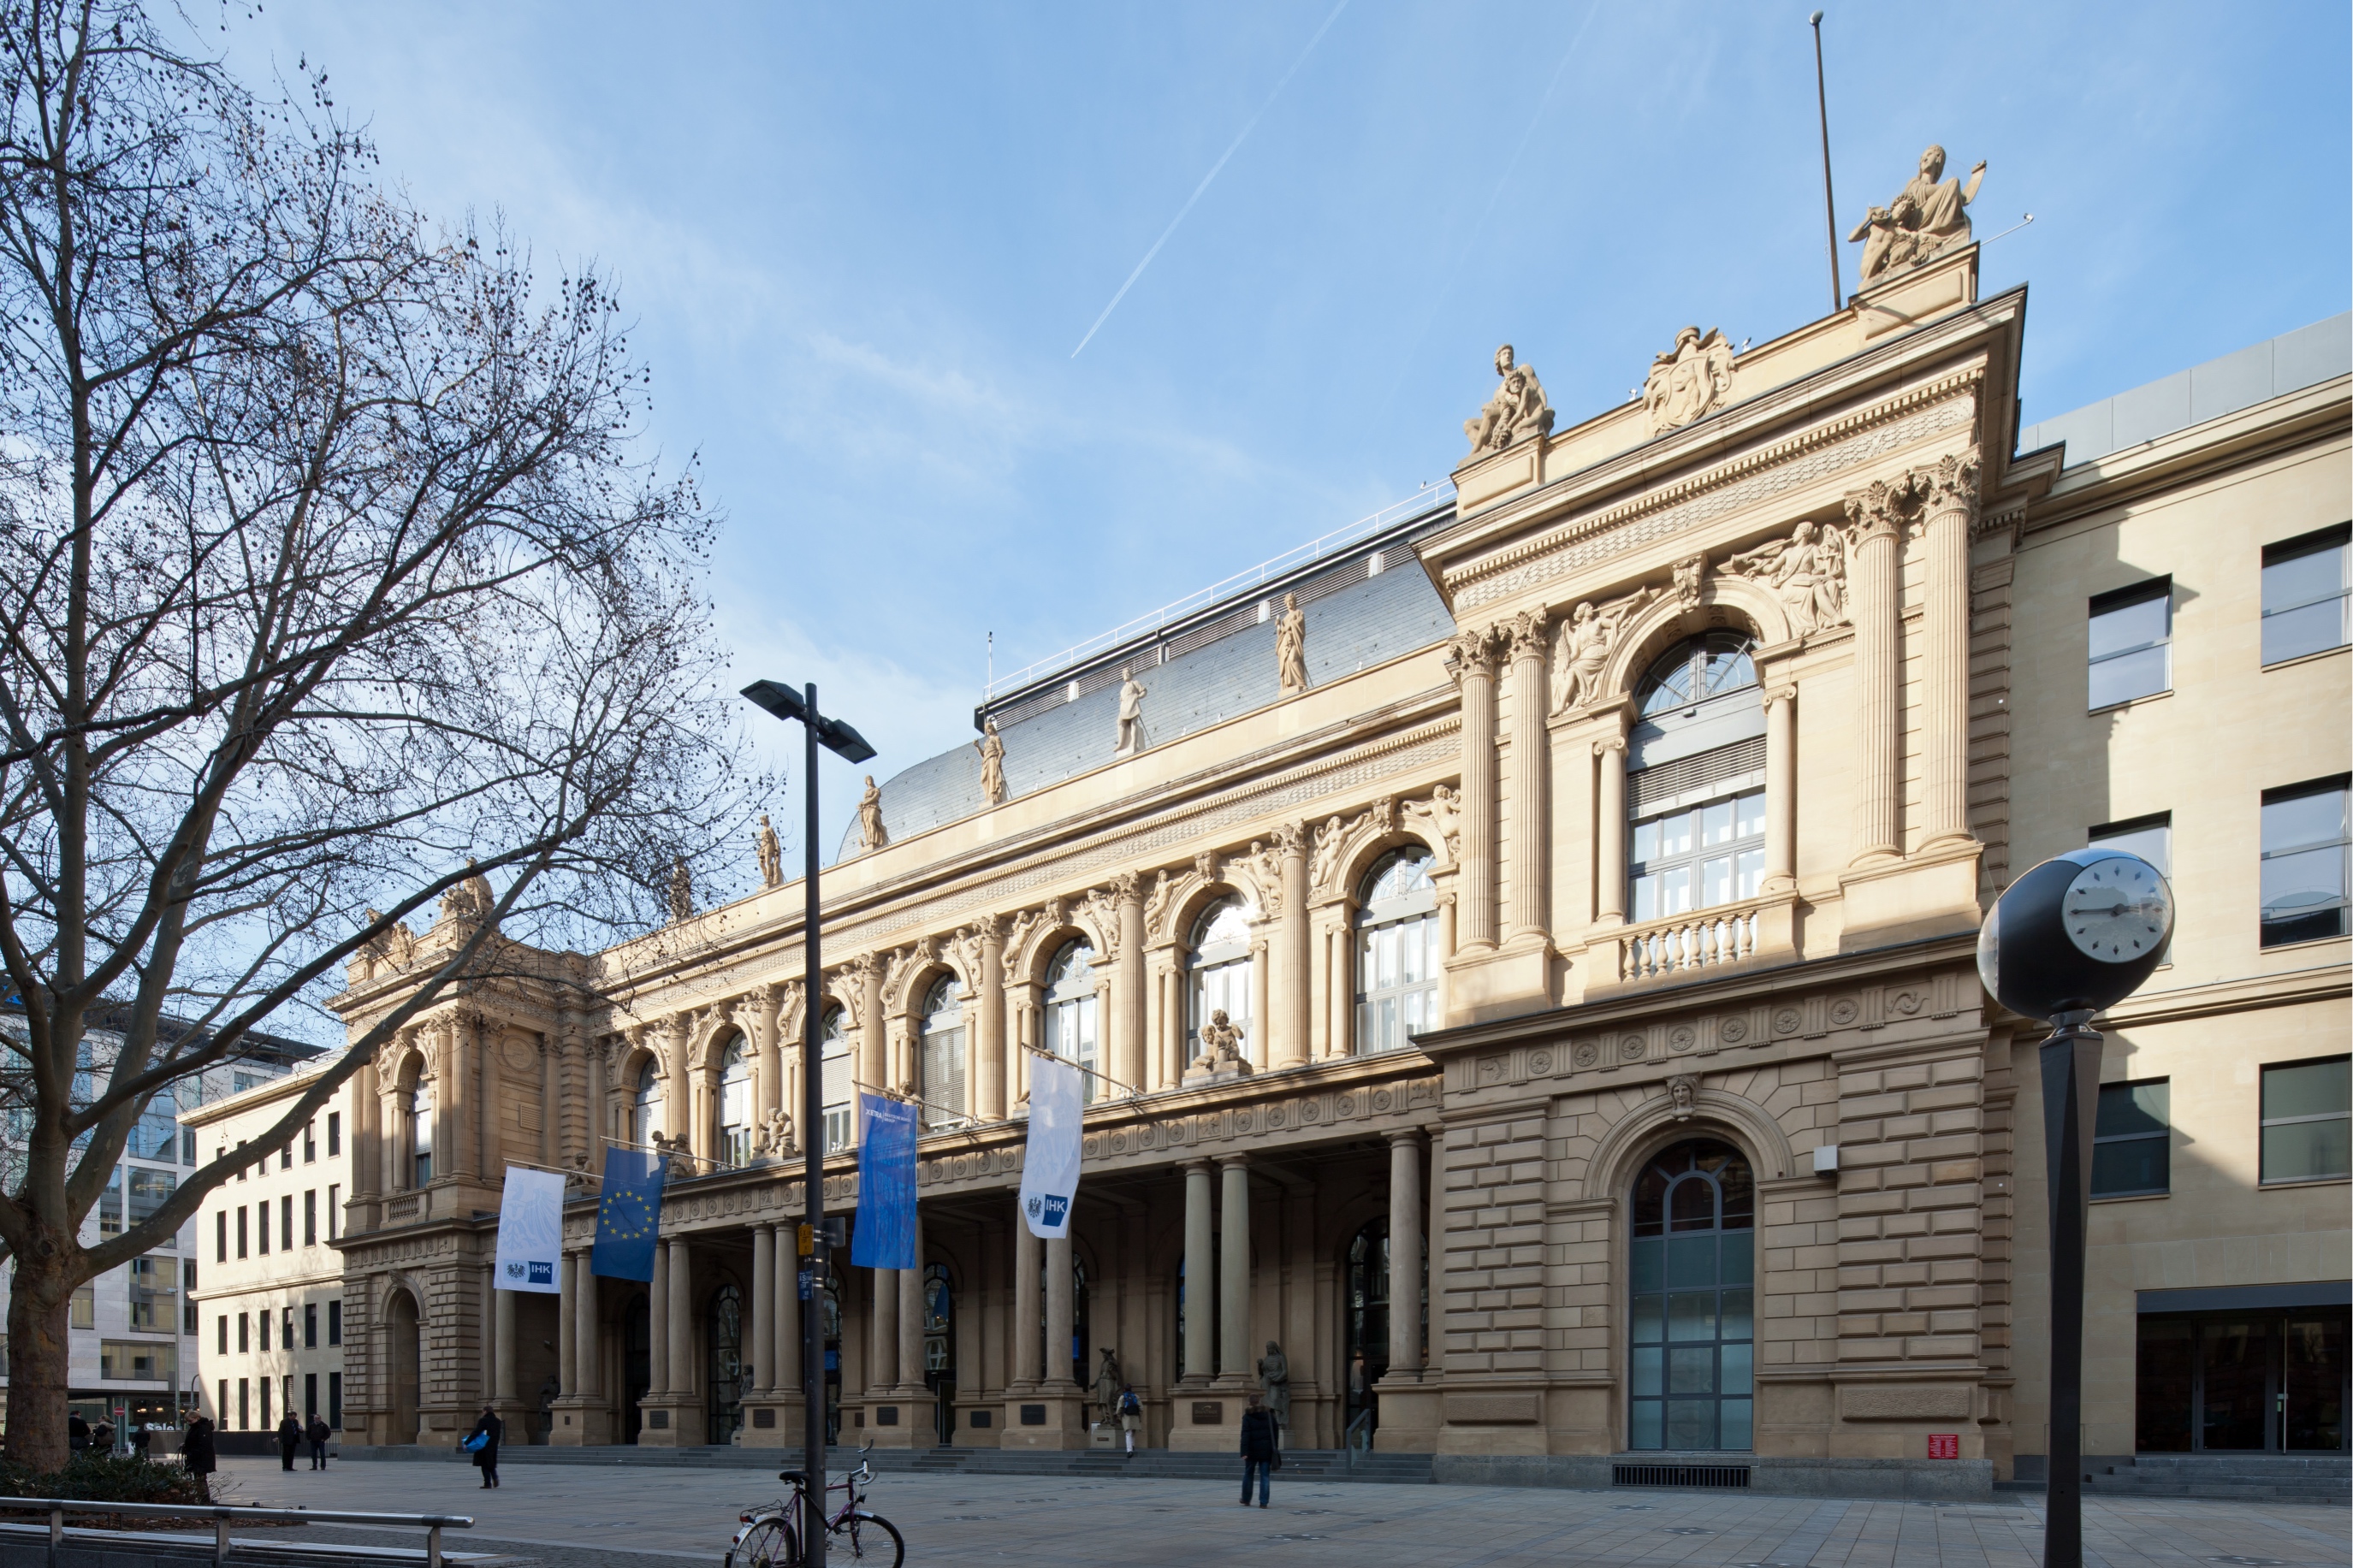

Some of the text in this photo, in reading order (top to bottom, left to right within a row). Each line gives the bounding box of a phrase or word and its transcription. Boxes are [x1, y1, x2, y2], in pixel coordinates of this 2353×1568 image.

[865, 1109, 882, 1119] XETRA
[1046, 1199, 1065, 1213] IHK
[531, 1264, 550, 1274] IHK
[145, 1423, 175, 1431] Sale
